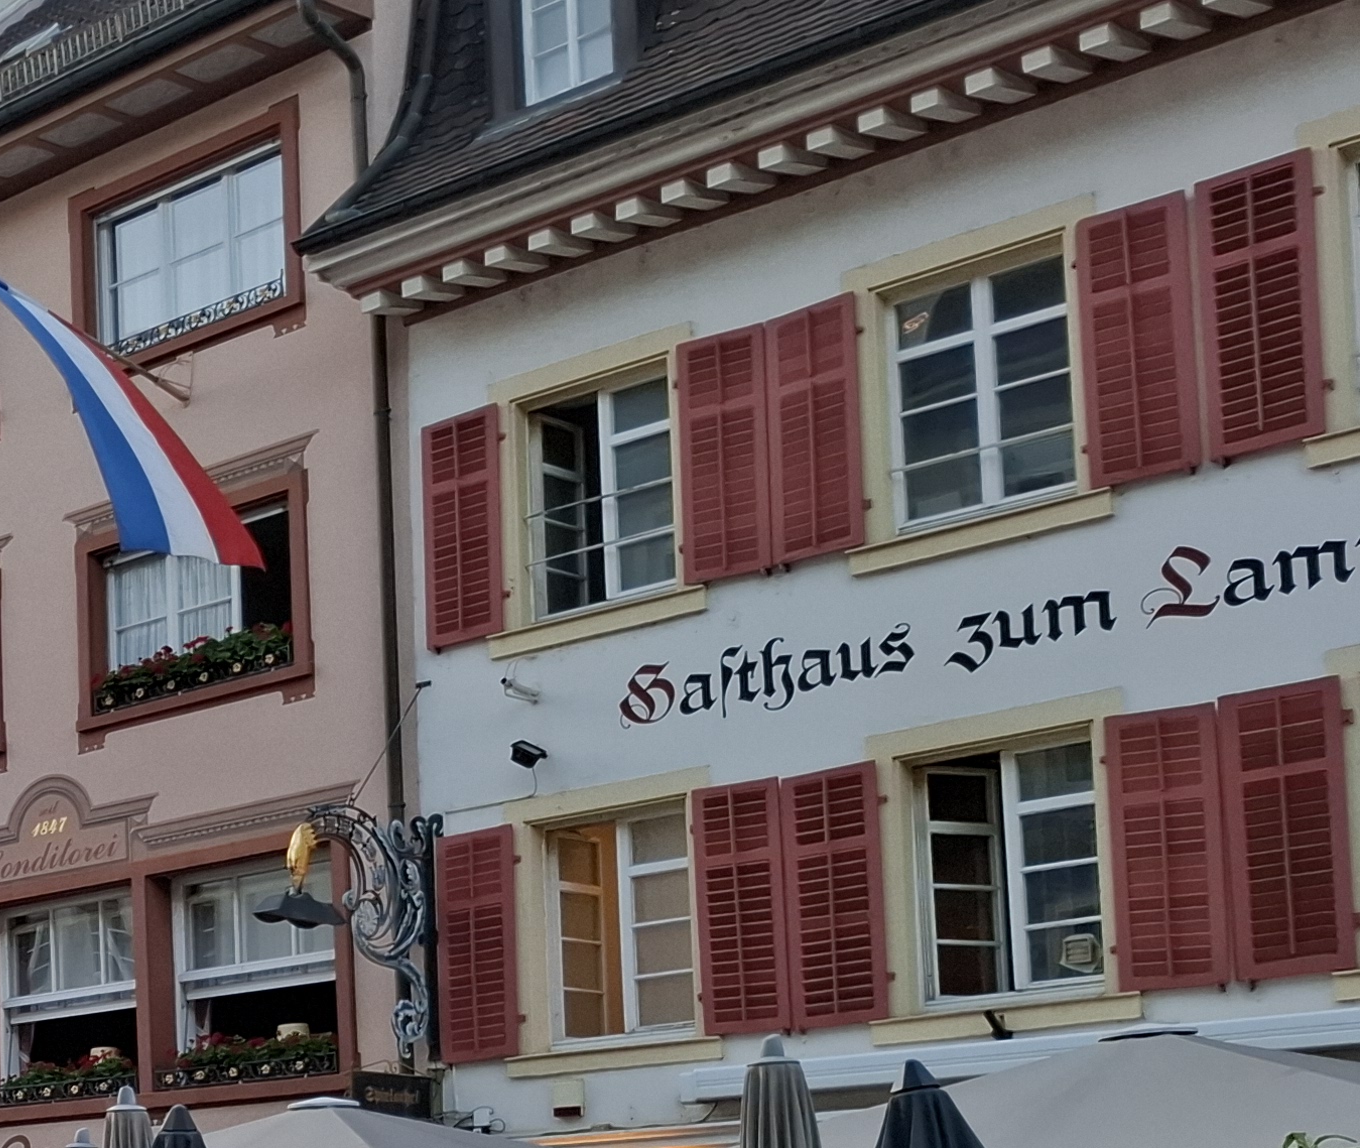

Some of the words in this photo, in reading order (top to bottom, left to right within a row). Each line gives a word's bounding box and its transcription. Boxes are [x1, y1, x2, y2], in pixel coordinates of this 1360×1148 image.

[942, 590, 1118, 673] zum
[1140, 538, 1360, 630] Lam
[31, 816, 68, 837] 1847
